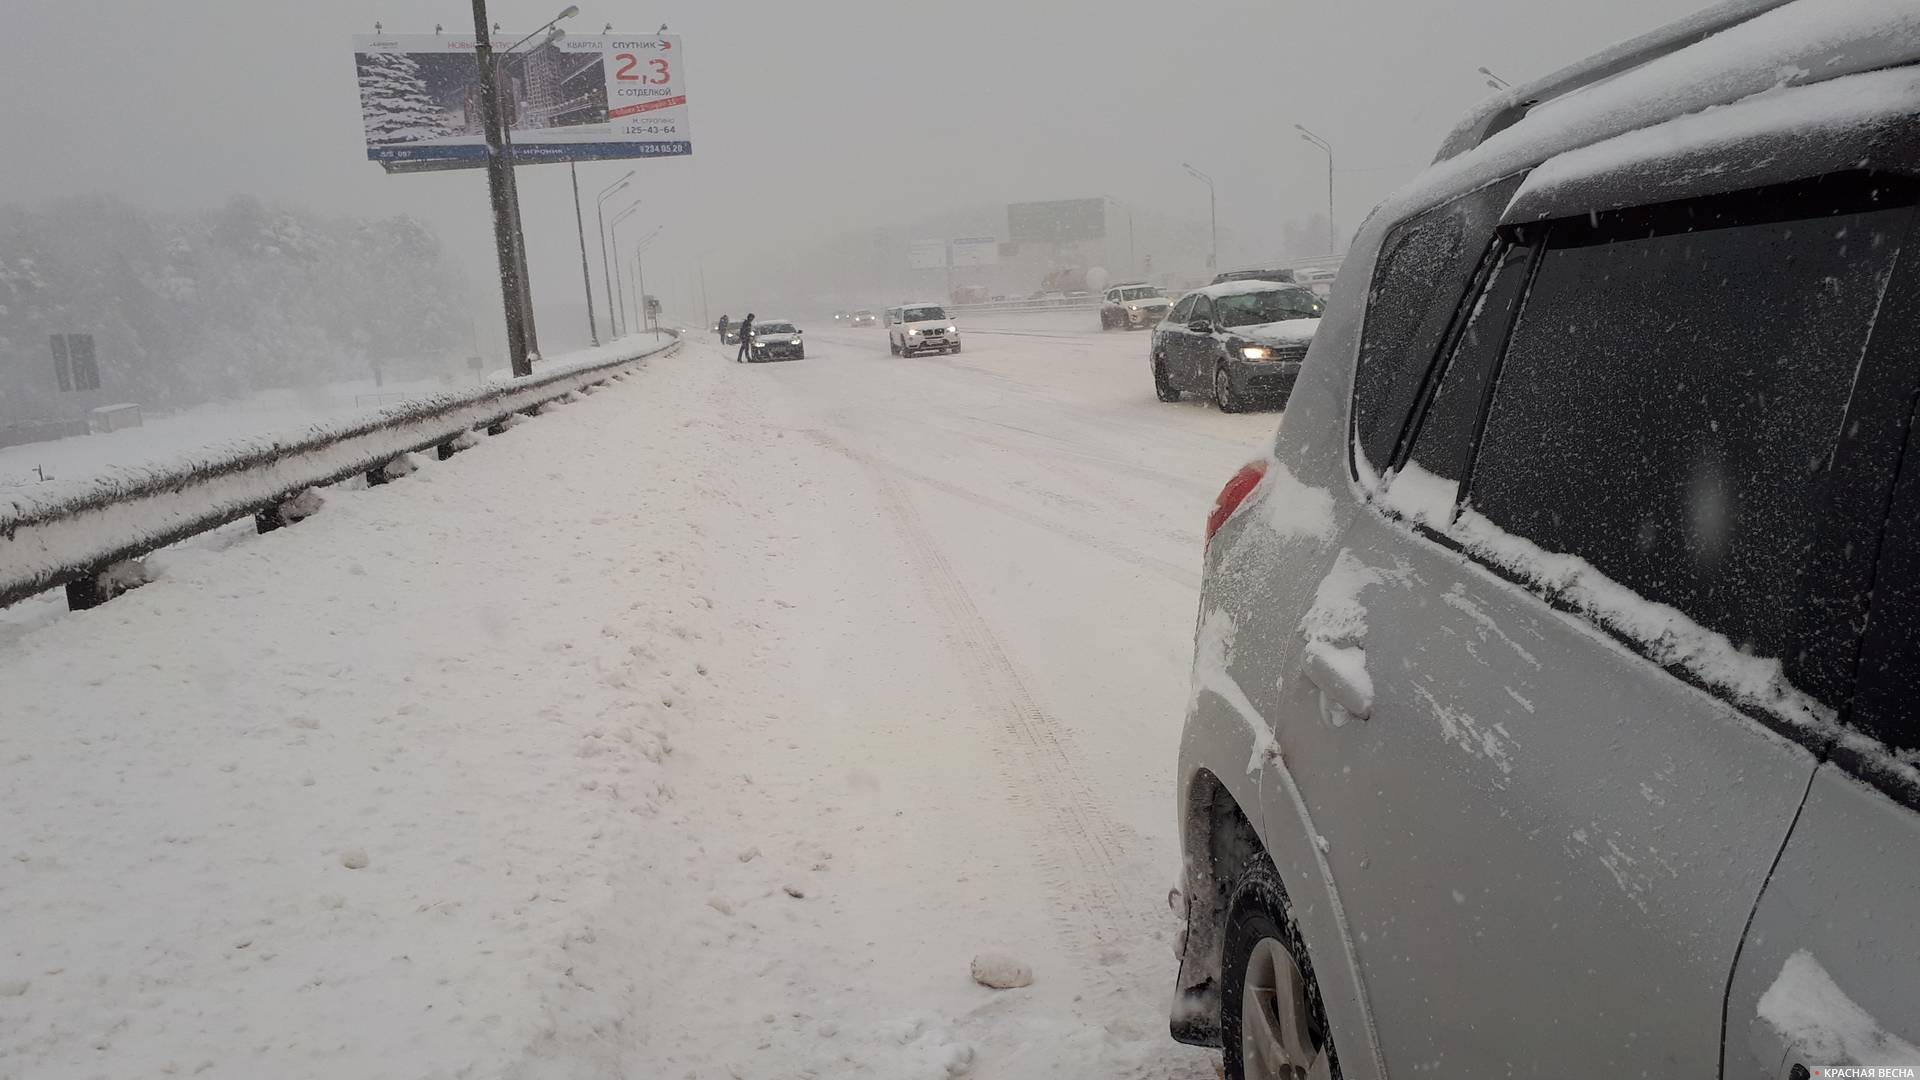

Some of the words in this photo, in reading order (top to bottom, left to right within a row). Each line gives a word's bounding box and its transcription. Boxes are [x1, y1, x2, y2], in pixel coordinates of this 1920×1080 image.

[566, 41, 603, 49] КВАРТАЛ
[612, 41, 656, 49] СПУТНИК
[615, 53, 671, 85] 2,3
[625, 87, 672, 97] ОТДЕЛКОЙ
